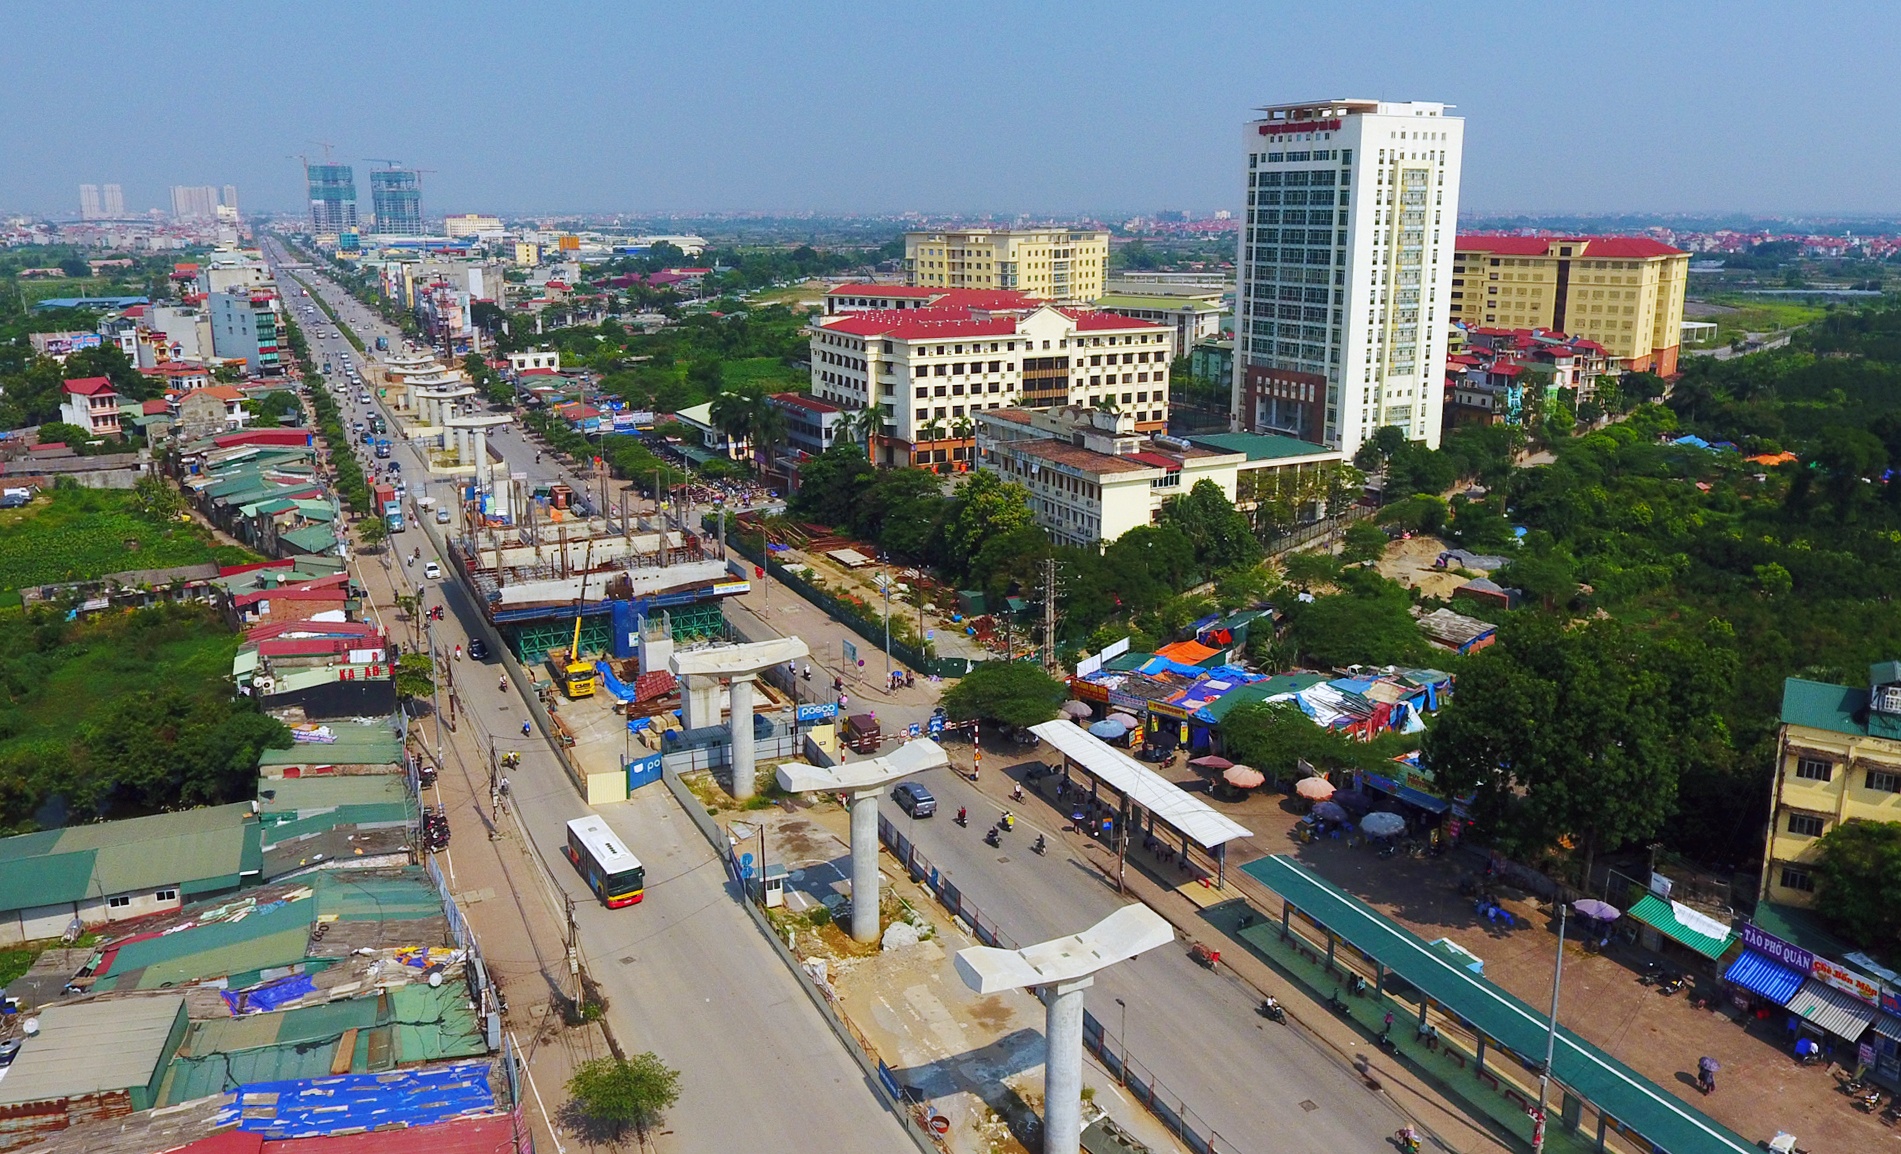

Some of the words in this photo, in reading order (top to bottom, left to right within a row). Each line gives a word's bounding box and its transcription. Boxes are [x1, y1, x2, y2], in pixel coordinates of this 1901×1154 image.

[801, 704, 835, 718] posco
[1744, 928, 1763, 947] TÀO
[1764, 938, 1783, 956] PHỚ
[1783, 948, 1811, 969] QUÁN
[1813, 961, 1832, 974] Chè
[1833, 969, 1853, 985] Bốn
